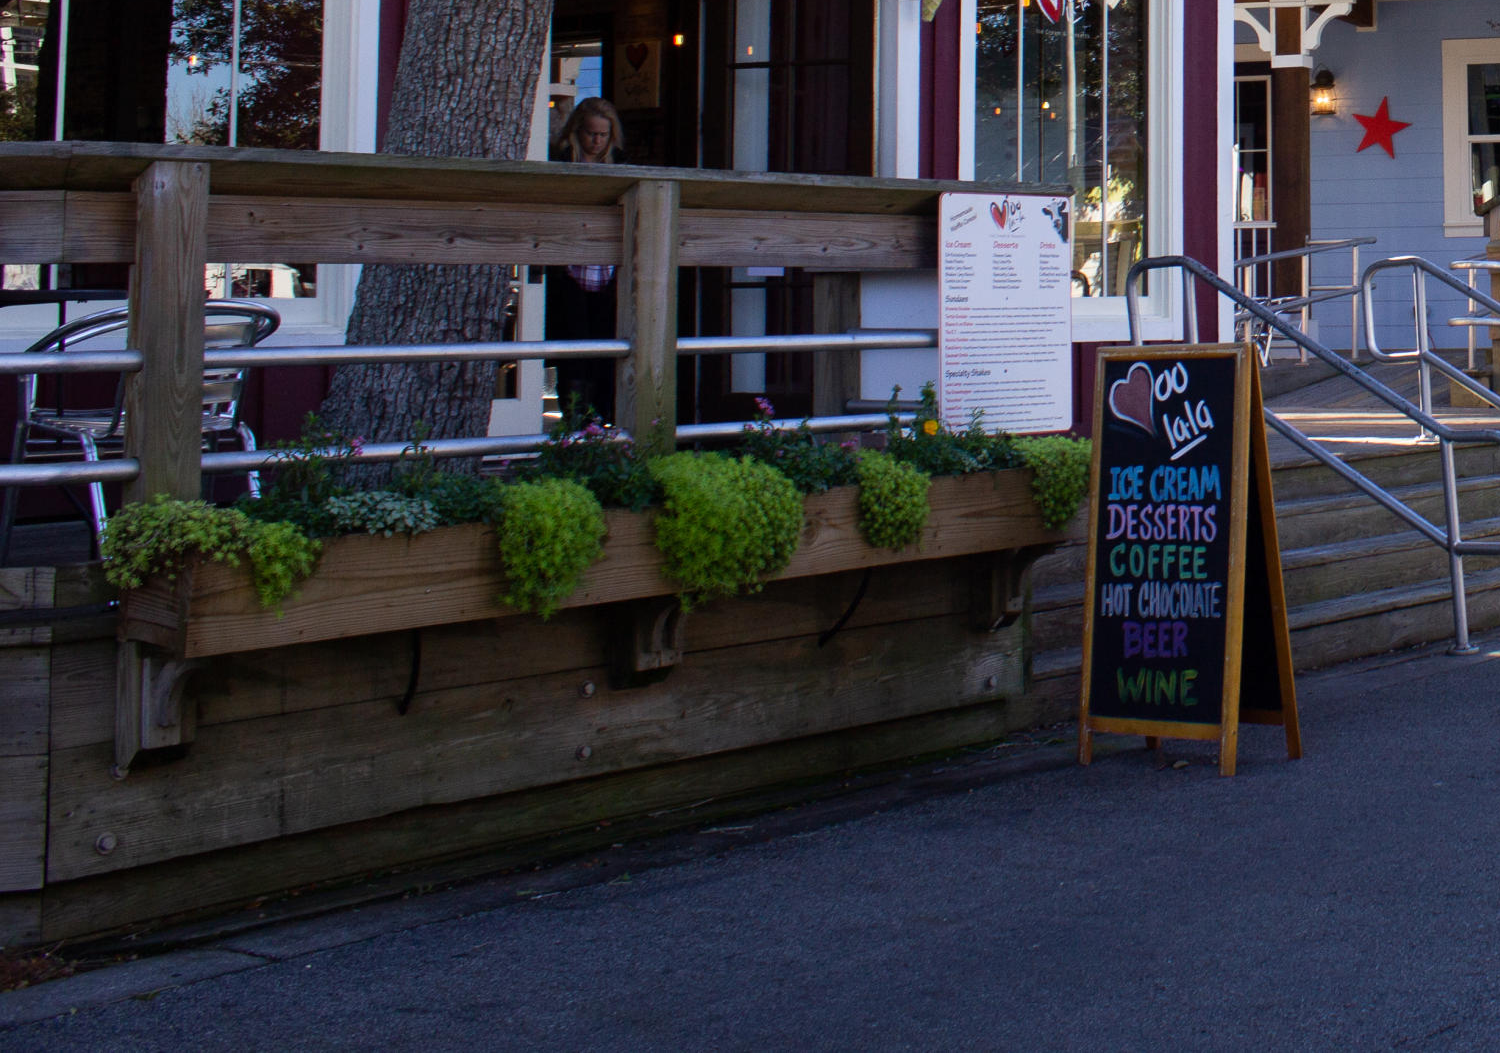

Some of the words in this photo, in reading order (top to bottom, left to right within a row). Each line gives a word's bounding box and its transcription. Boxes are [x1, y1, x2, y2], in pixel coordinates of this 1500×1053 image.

[1108, 465, 1144, 501] ICE
[1150, 464, 1222, 502] CREAM
[1106, 504, 1218, 542] DESSERTS
[1110, 543, 1208, 580] COFFEE
[1101, 583, 1133, 617] HOT
[1138, 582, 1222, 619] CHOCOLATE
[1122, 621, 1189, 659] BEER
[1117, 668, 1199, 706] WINE
